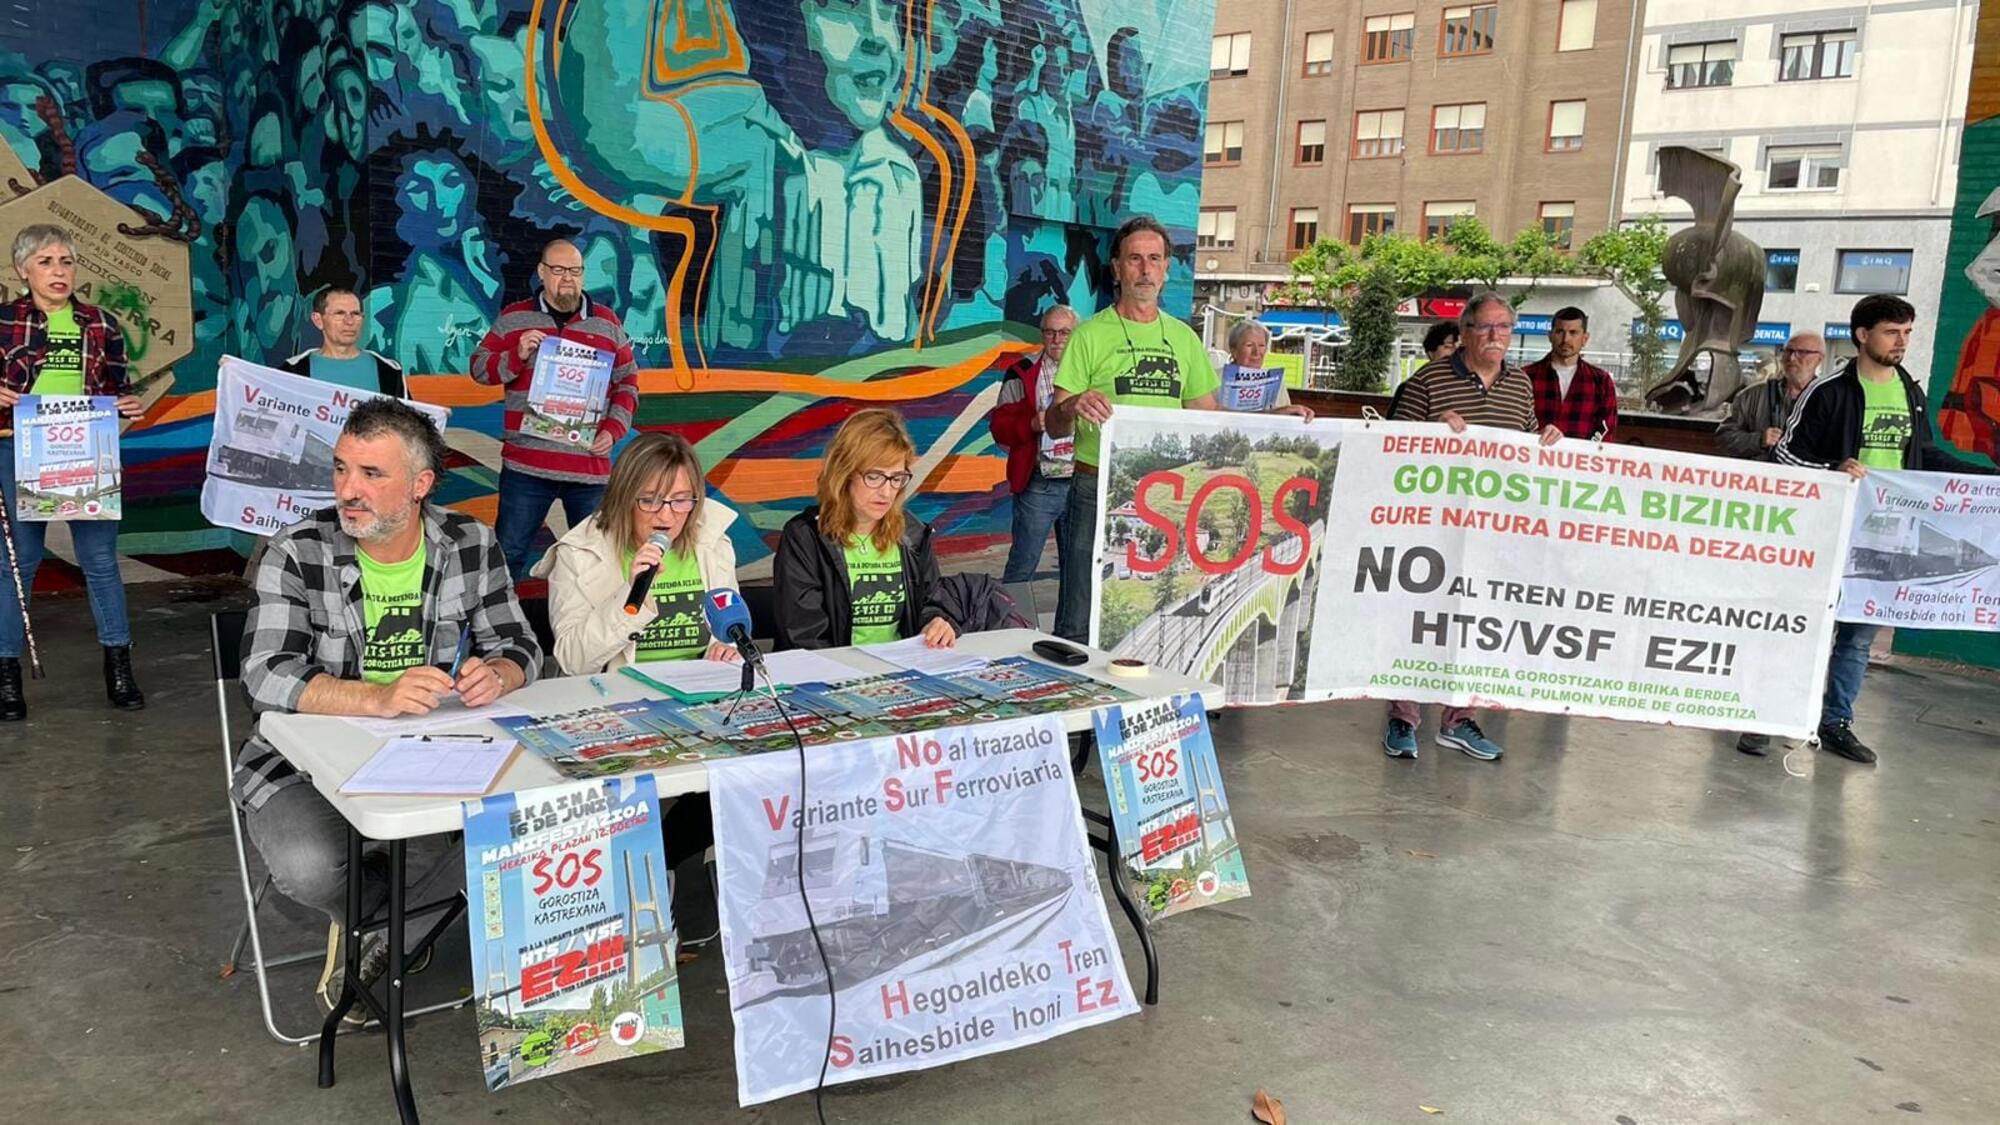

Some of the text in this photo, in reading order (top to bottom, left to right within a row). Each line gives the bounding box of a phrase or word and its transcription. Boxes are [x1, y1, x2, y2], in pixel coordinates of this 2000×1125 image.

[113, 257, 143, 277] VASCO
[1754, 329, 1787, 340] DENTAL
[557, 366, 586, 383] SOS
[1238, 388, 1262, 399] SOS
[244, 385, 346, 426] Variante Sur
[47, 426, 85, 442] SOS
[1382, 435, 1822, 500] DEFENDAMOS NUESTRA NATURALEZA
[1944, 478, 1970, 495] No
[1971, 482, 1982, 496] al
[241, 506, 288, 530] Saihe
[1393, 464, 1799, 536] GOROSTIZA BIZIRIK
[1876, 487, 1930, 511] Variante
[1932, 495, 1958, 512] Sur
[1126, 470, 1320, 576] SOS
[1370, 505, 1816, 569] GURE NATURA DEFENDA DEZAGUN
[1353, 546, 1808, 634] NO AL TREN DE MERCANCIAS
[1863, 599, 1937, 623] Saihesbide
[1974, 607, 1998, 625] Ez
[1971, 587, 2000, 606] Tren
[1411, 610, 1737, 676] HTS/VSF EZ!!
[1369, 674, 1757, 720] ASOCIACION VECINAL PULMON VERDE DE GOROSTIZA
[1391, 658, 1742, 703] AUZO-ELKARTEA GOROSTIZAKO BIRIKA BERDEA
[1133, 722, 1148, 736] DE
[1150, 709, 1182, 729] JUNIO
[896, 725, 1053, 771] No al trazado
[1137, 748, 1179, 782] SOS
[511, 794, 620, 839] 16 DE JUNIO
[762, 759, 1063, 832] Variante Sur Ferroviaria
[481, 800, 650, 866] MANIFESTAZIOA
[499, 849, 547, 872] HERRIKO
[551, 834, 592, 855] PLAZAN
[533, 848, 603, 896] SOS
[534, 902, 606, 925] KASTREXANA
[538, 887, 600, 910] GOROSTIZA
[520, 941, 561, 969] HTS
[582, 918, 624, 944] VSF
[520, 934, 625, 1002] EZ!!!
[880, 939, 1108, 1020] Hegoaldeko Tren
[829, 976, 1120, 1068] Saihesbide honi Ez
